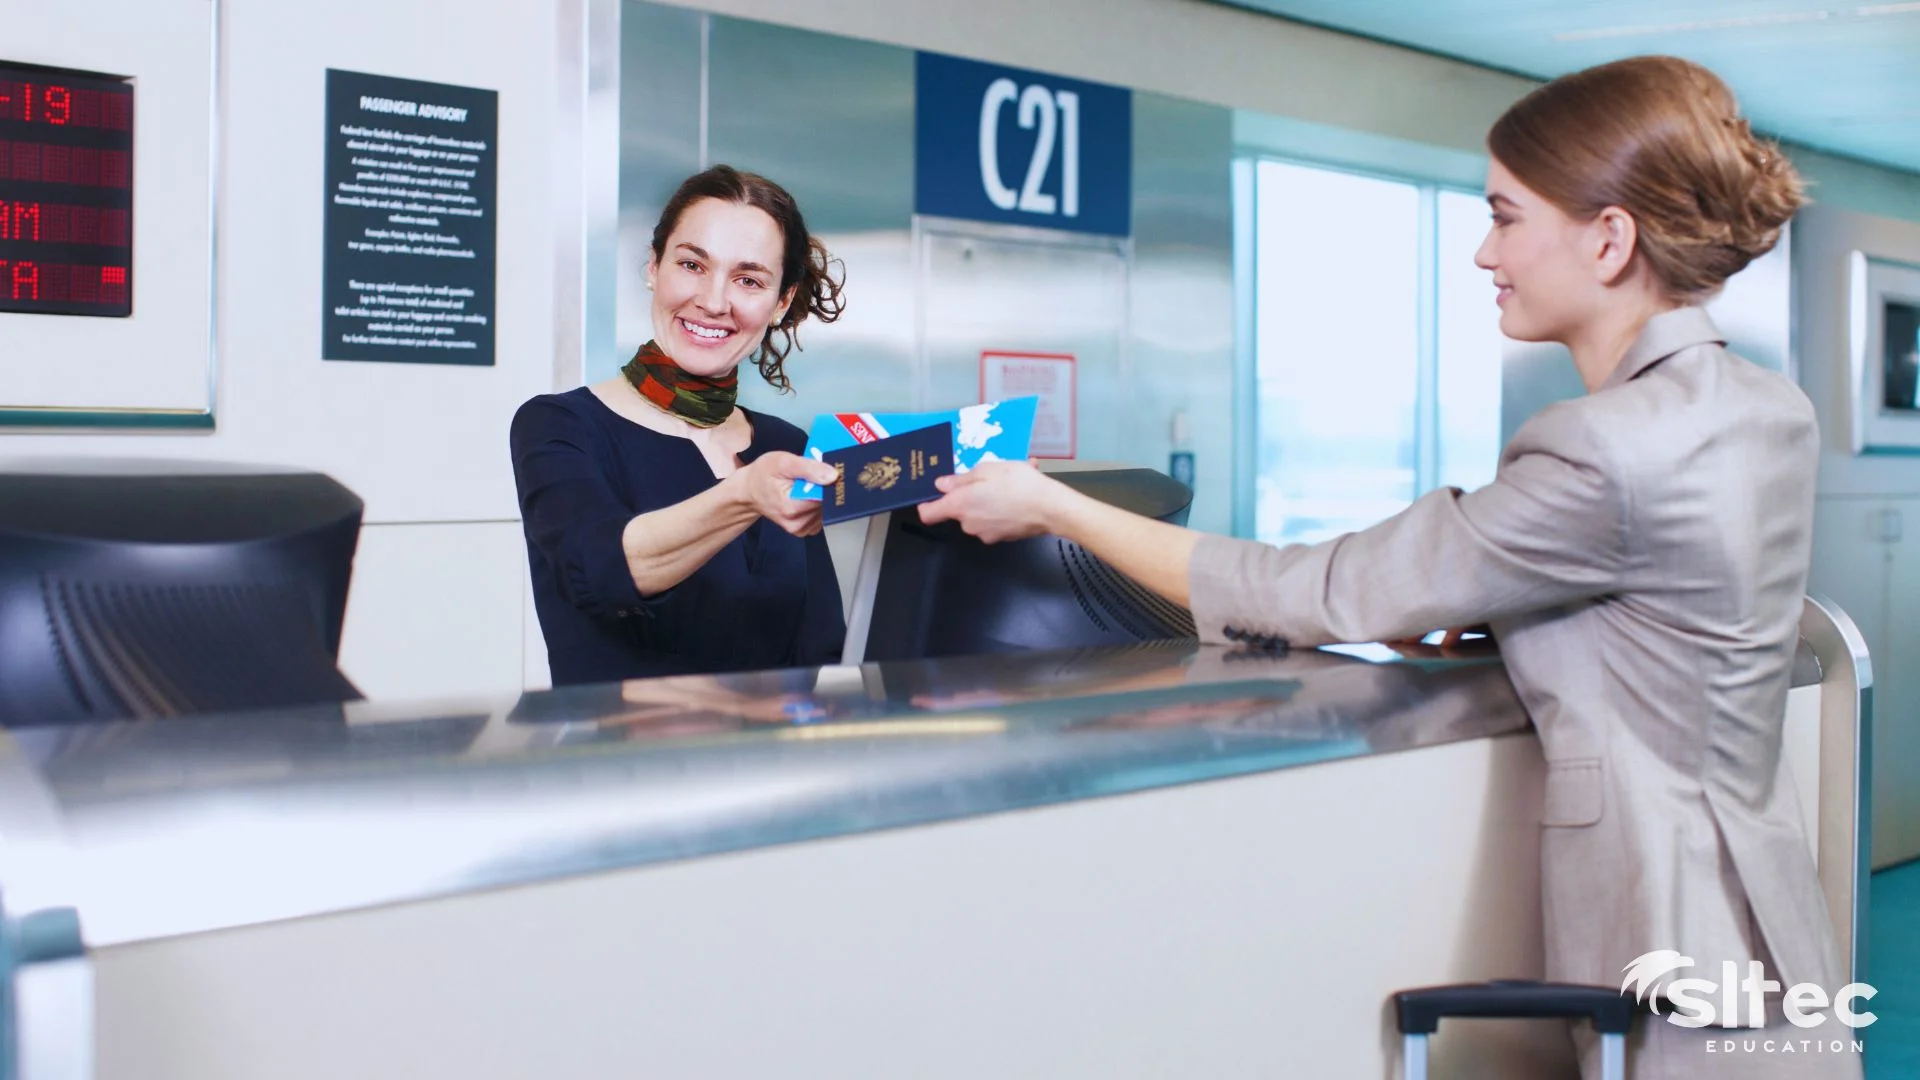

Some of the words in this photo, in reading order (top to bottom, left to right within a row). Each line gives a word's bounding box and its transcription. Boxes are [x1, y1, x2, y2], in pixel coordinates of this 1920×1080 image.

[360, 96, 417, 116] PASSENGER
[418, 104, 467, 122] ADVISORY
[979, 77, 1079, 217] C21
